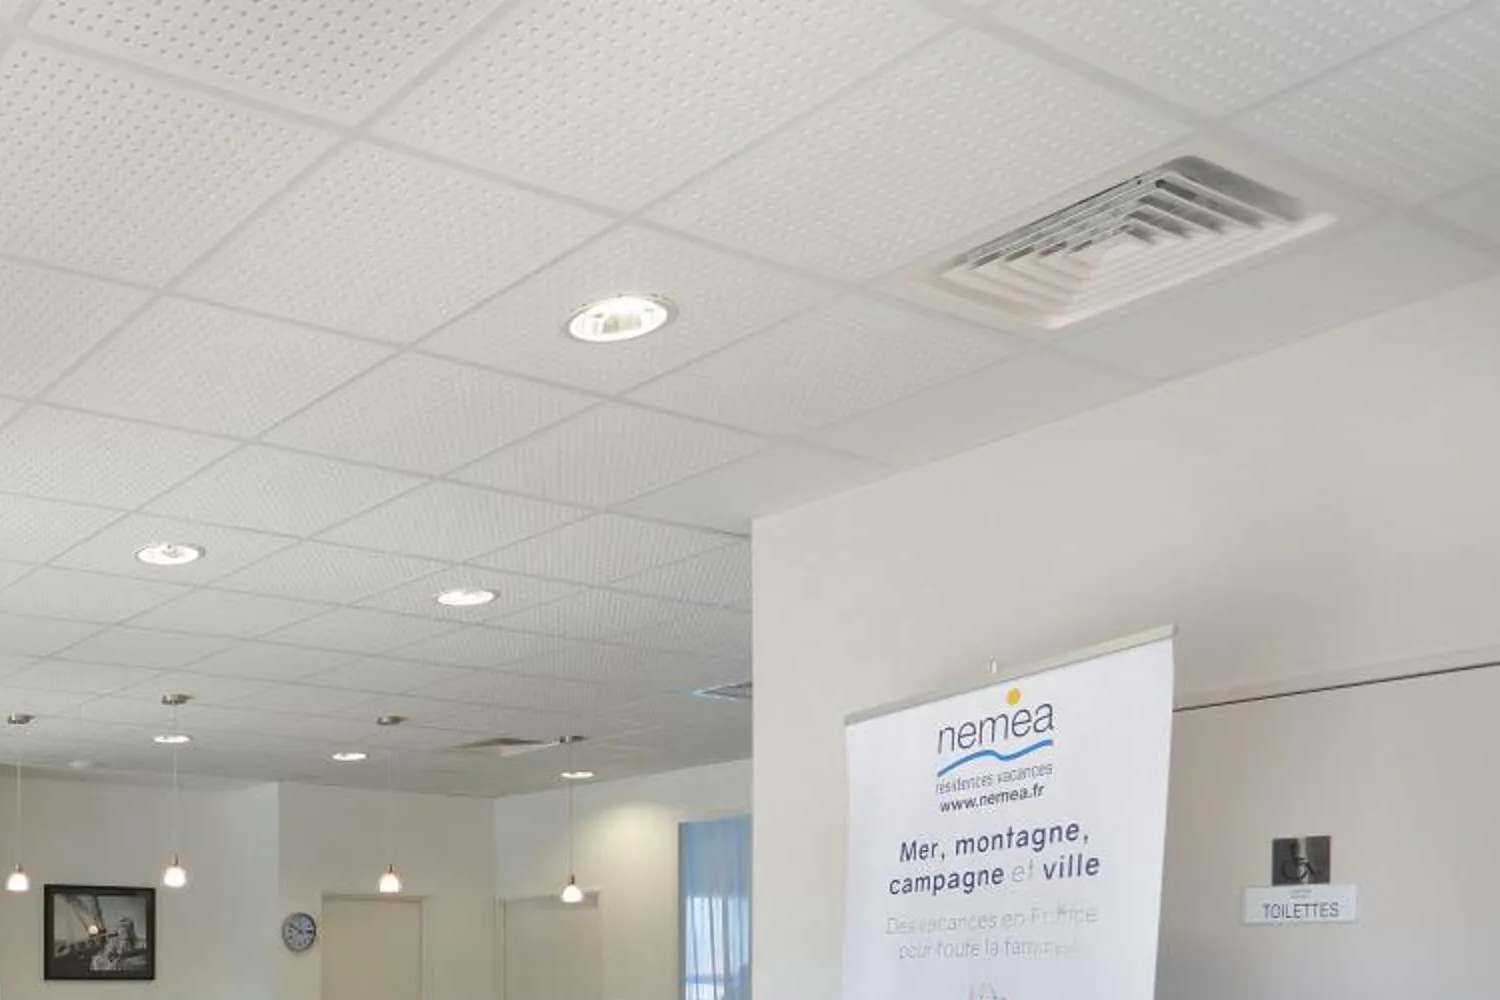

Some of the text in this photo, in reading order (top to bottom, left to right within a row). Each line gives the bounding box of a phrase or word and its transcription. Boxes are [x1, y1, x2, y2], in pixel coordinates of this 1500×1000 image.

[937, 703, 1054, 755] nemea
[939, 783, 1045, 813] www.nemea.fr
[899, 823, 1089, 862] Mer, montagne,
[889, 853, 1100, 896] campagne et ville
[1264, 901, 1340, 919] TOILETTES
